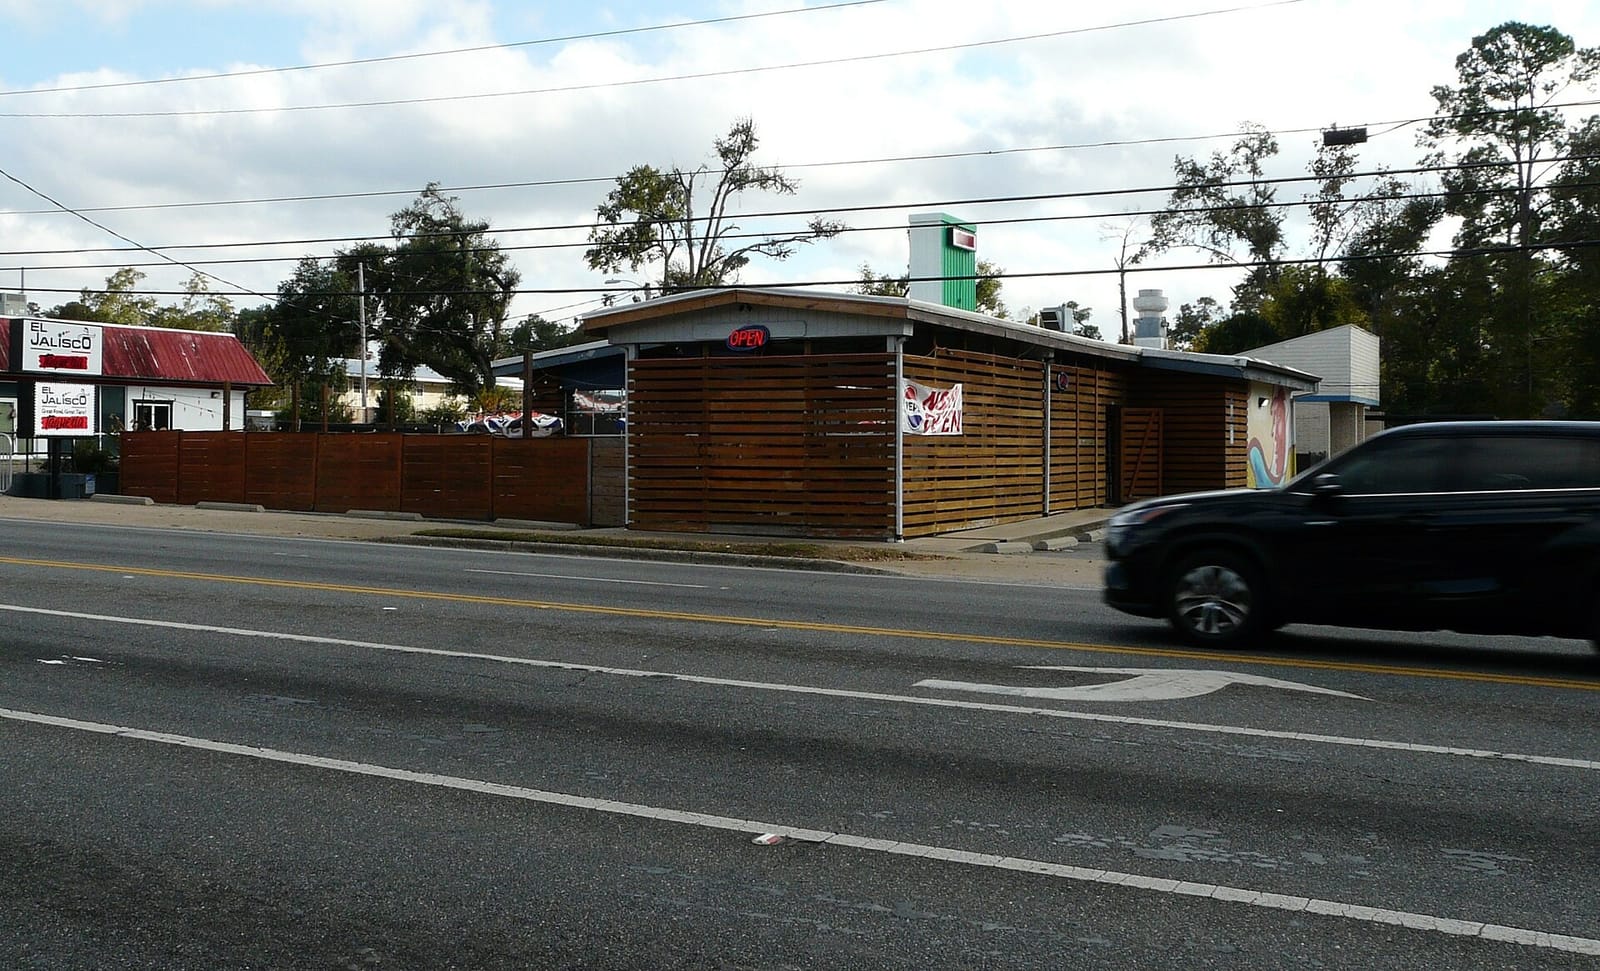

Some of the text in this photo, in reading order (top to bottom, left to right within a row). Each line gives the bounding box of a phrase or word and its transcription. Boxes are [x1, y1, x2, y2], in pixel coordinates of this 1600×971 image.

[30, 322, 47, 333] EL
[730, 330, 765, 346] OPEN
[42, 386, 54, 394] EL
